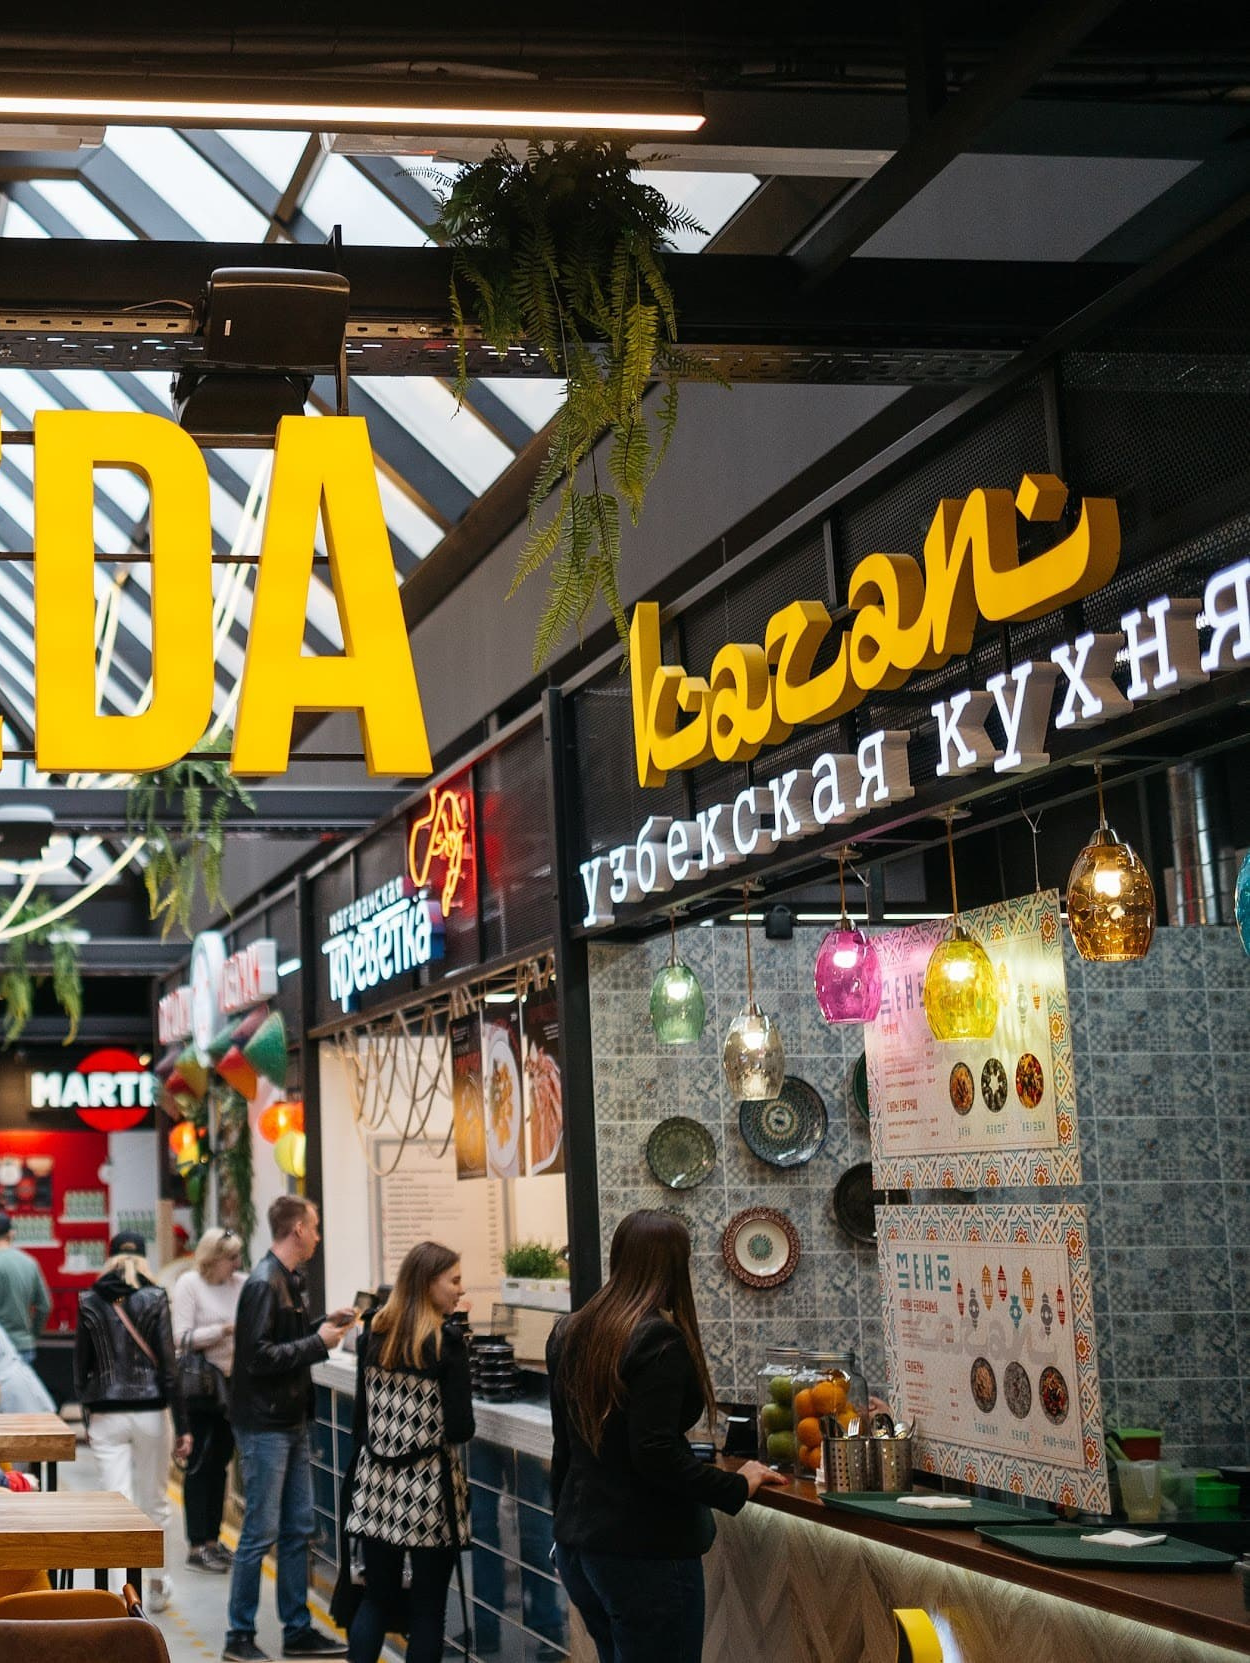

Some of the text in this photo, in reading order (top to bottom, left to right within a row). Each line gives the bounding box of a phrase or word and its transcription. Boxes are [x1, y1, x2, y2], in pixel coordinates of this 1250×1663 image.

[579, 556, 1250, 928] узбекская кухня
[895, 1252, 951, 1293] МЕНЮ
